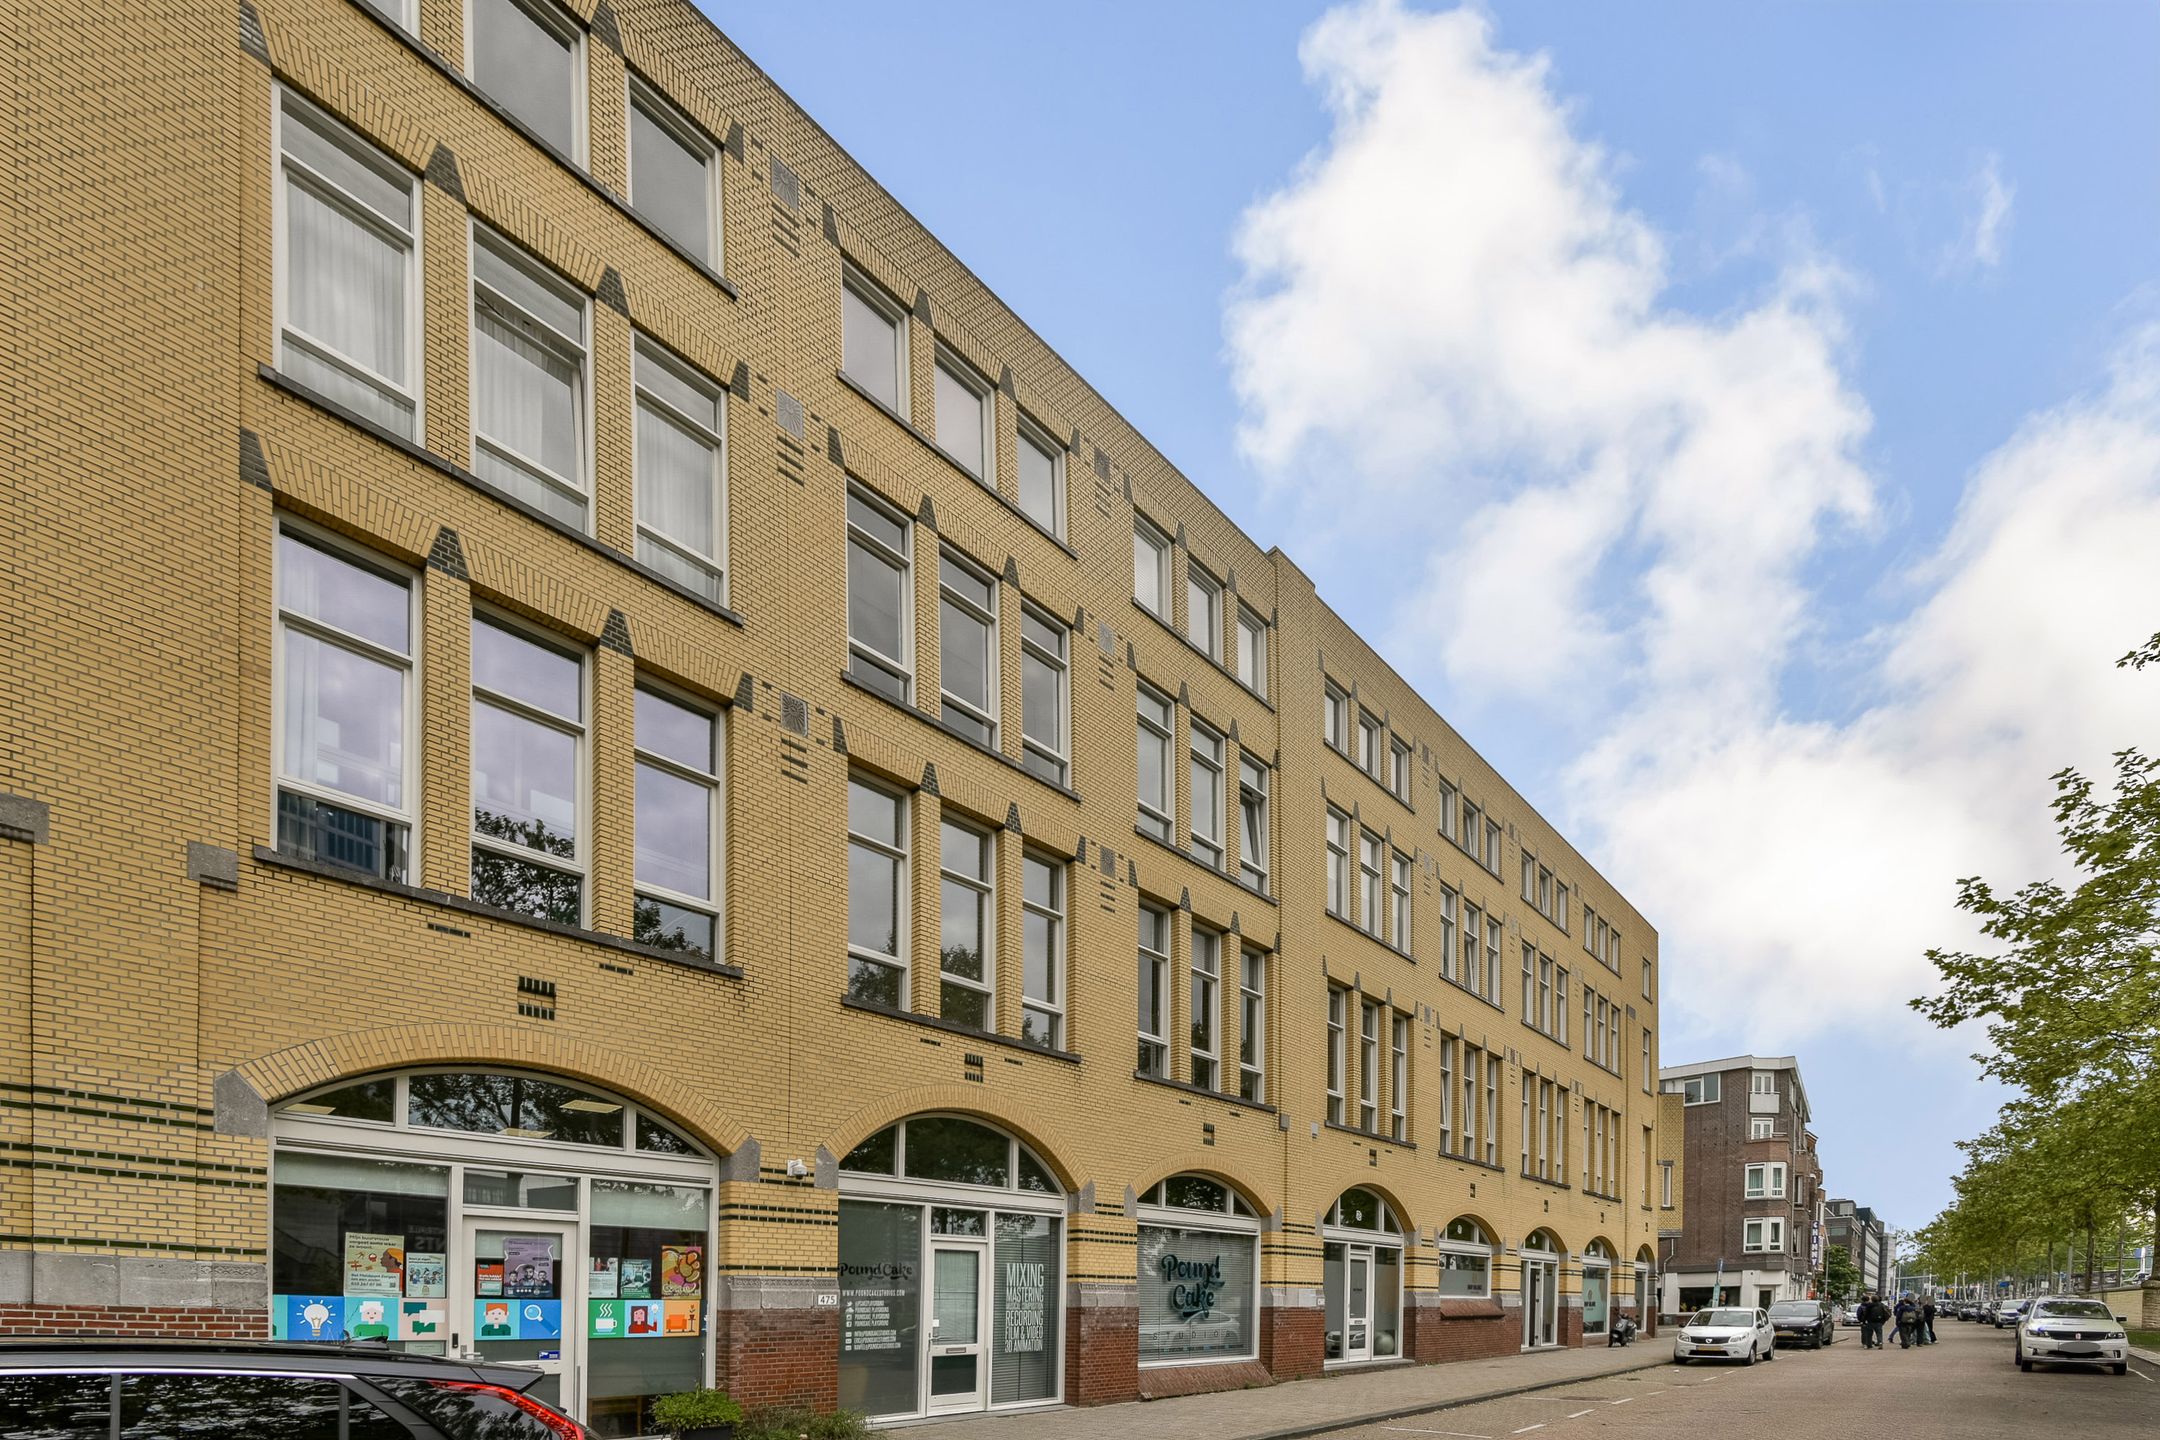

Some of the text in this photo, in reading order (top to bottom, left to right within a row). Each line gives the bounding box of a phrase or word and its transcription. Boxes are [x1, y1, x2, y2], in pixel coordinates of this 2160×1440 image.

[1006, 1262, 1044, 1287] MIXING
[1160, 1254, 1225, 1289] Pound
[820, 1296, 836, 1304] 475
[1006, 1287, 1044, 1302] MASTERING
[1172, 1283, 1215, 1318] Cake
[1006, 1310, 1044, 1326] RECORDING
[1005, 1325, 1044, 1340] FILM & VIDEO
[1005, 1339, 1043, 1353] 3D ANIMATION
